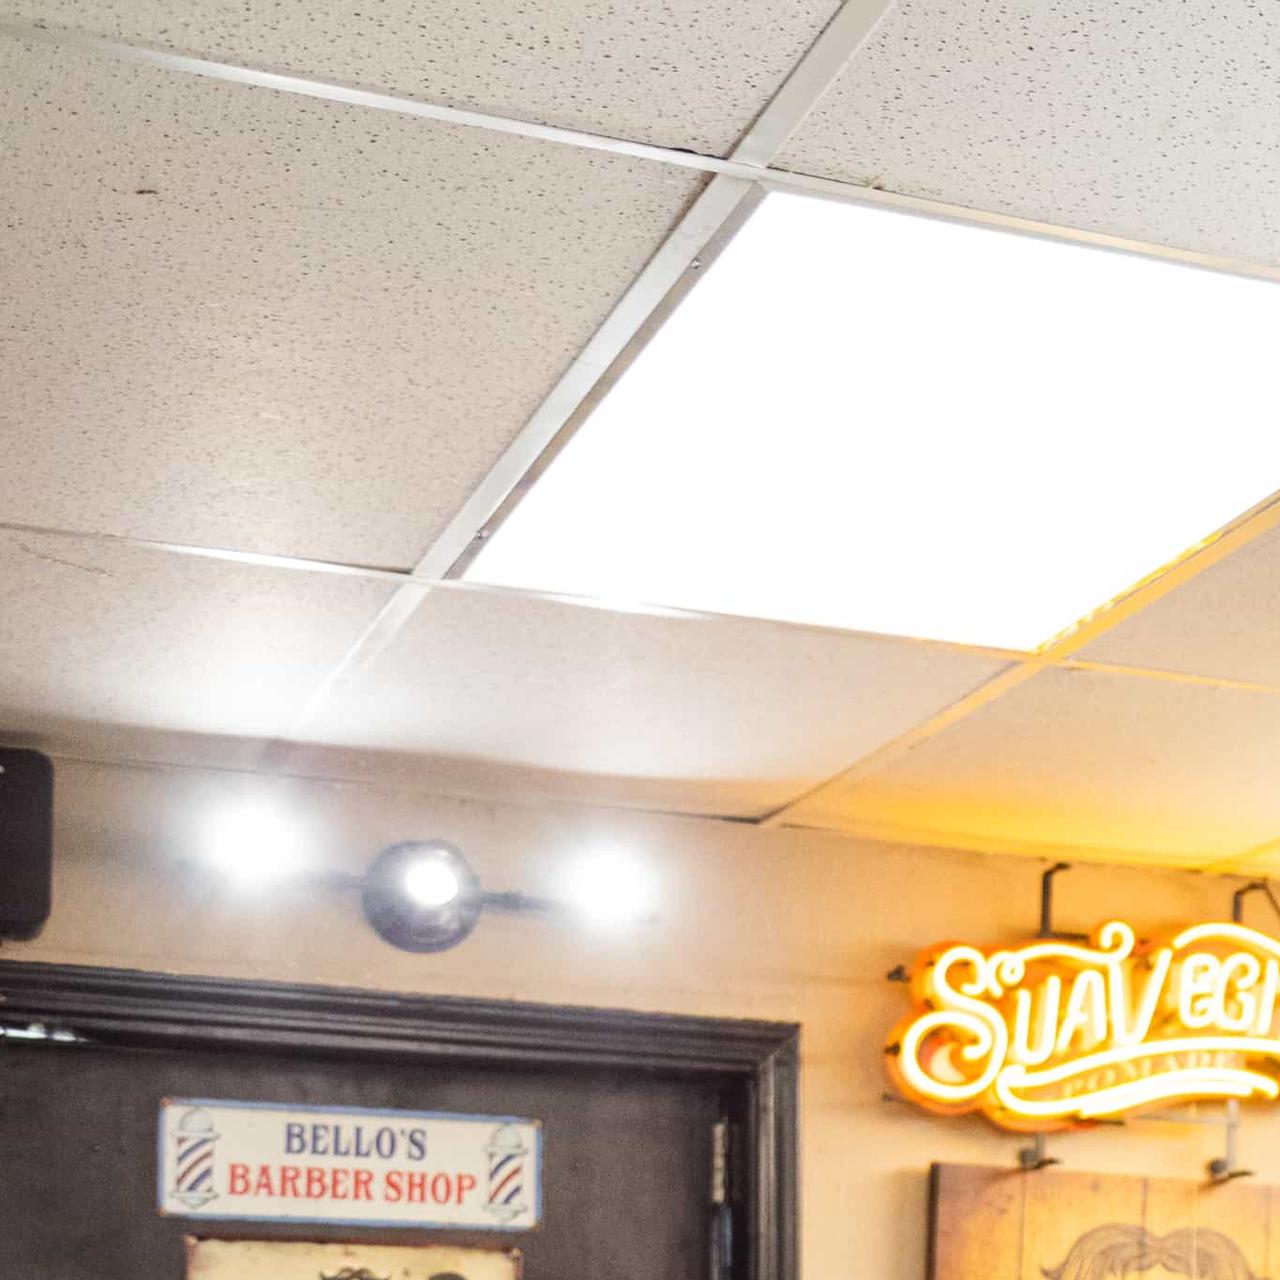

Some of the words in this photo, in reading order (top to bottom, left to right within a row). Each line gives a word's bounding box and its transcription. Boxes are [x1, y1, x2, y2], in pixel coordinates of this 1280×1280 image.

[285, 1123, 428, 1161] BELLO'S
[227, 1163, 375, 1201] BARBER
[384, 1169, 477, 1205] SHOP
